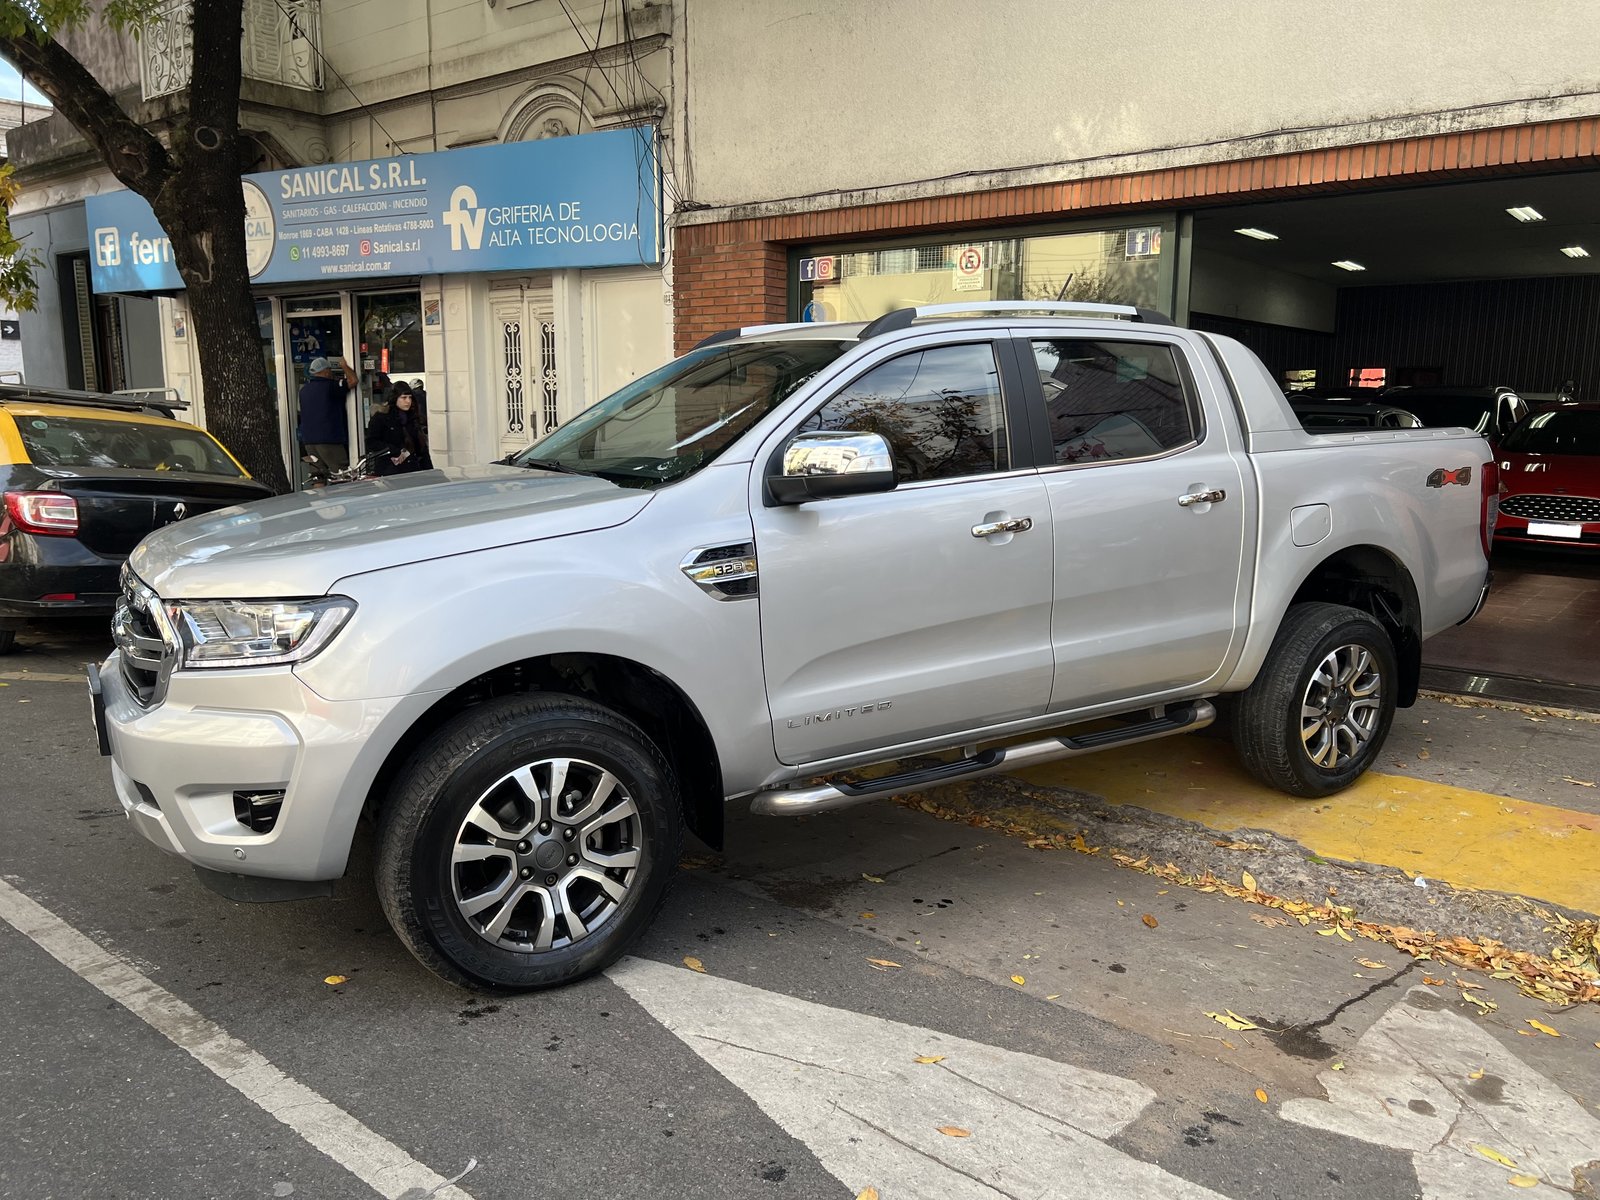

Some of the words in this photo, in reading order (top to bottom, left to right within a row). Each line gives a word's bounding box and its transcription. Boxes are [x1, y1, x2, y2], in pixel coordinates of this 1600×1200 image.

[280, 166, 365, 200] SANICAL
[369, 160, 427, 190] S.R.L.
[282, 207, 319, 220] SANITARIOS
[323, 205, 338, 215] GAS
[342, 200, 388, 214] CALEFACCION
[392, 197, 428, 210] INCENDIO
[488, 204, 555, 226] GRIFERIA
[559, 201, 582, 221] DE
[246, 221, 271, 238] CAL
[278, 231, 299, 241] Monroe
[316, 227, 334, 238] CABA
[373, 222, 402, 233] Rotativas
[488, 228, 523, 248] ALTA
[528, 222, 641, 245] TECNOLOGIA
[129, 231, 176, 265] ferr
[302, 247, 310, 259] 11
[311, 244, 350, 258] 4993-8697
[373, 238, 421, 254] Sanical.s.r.l
[320, 260, 392, 275] www.sanical.com.ar
[787, 700, 892, 729] LIMITED
